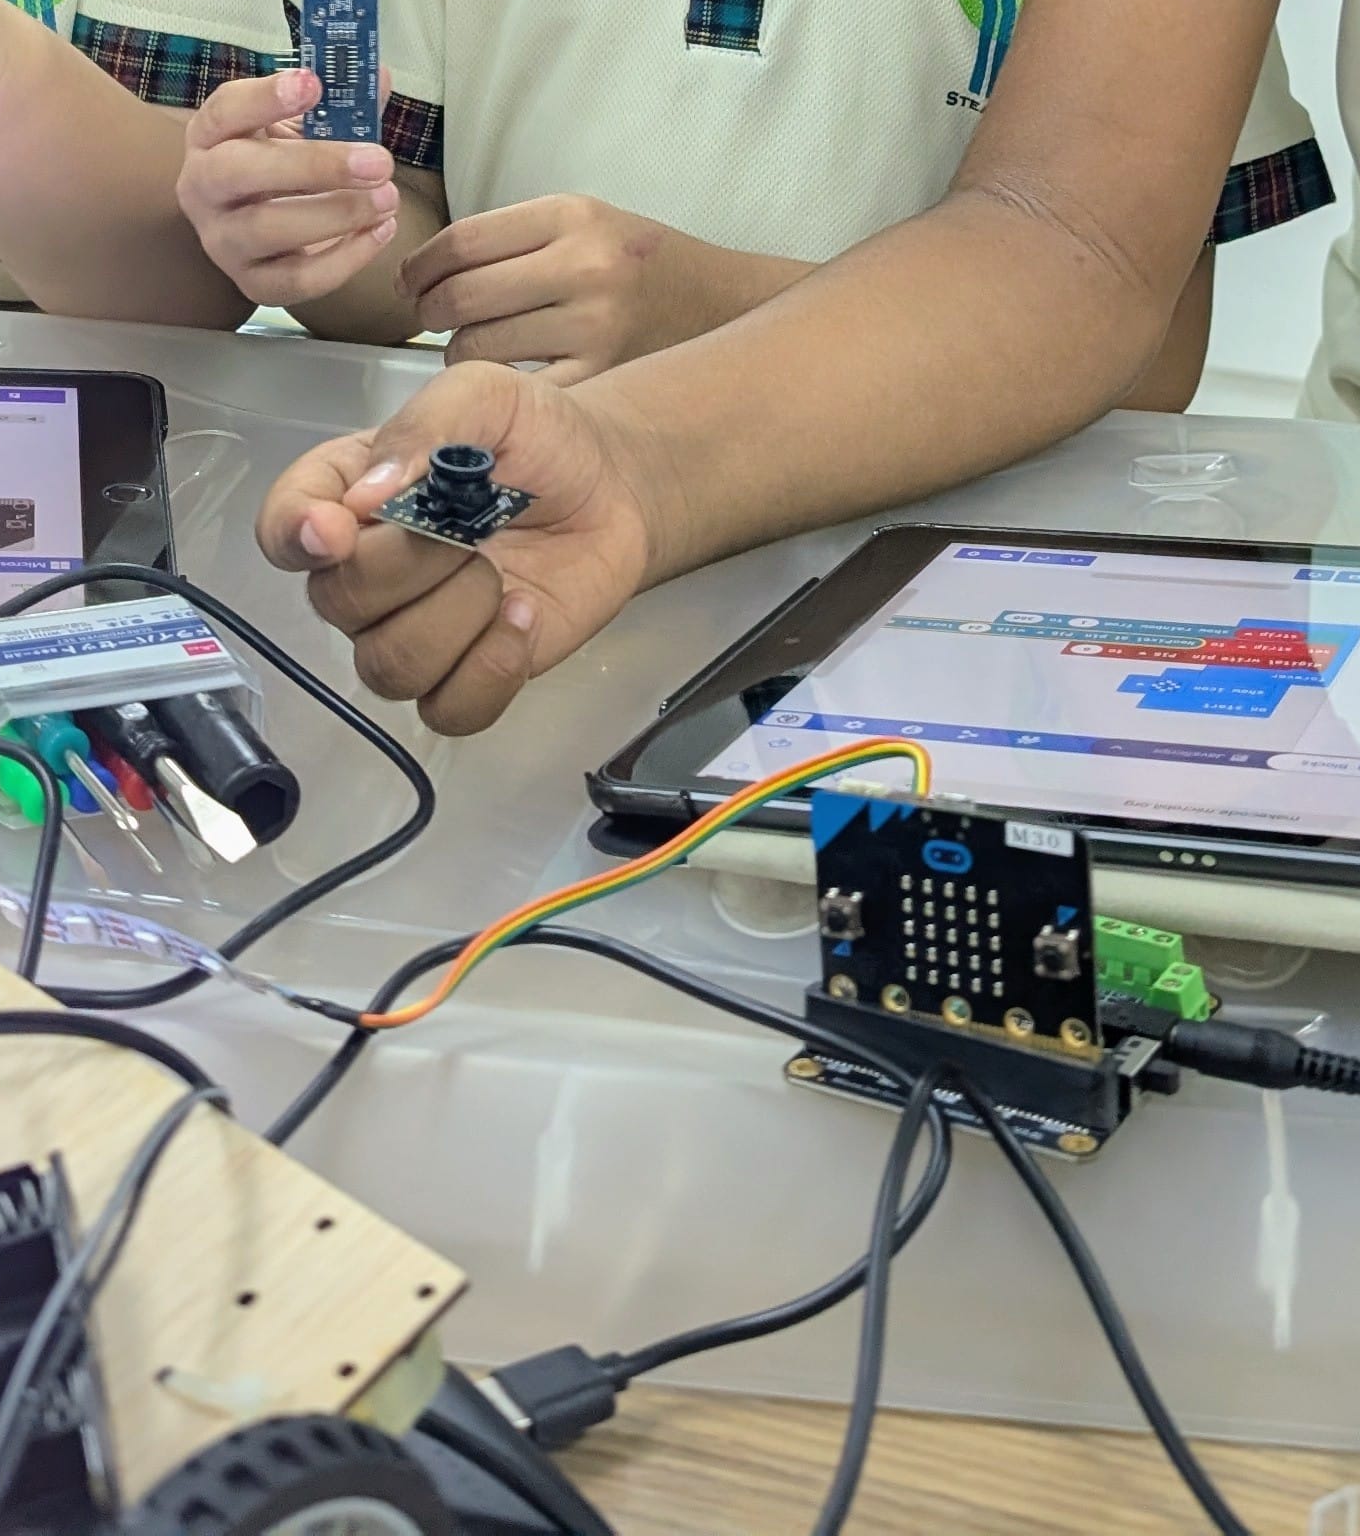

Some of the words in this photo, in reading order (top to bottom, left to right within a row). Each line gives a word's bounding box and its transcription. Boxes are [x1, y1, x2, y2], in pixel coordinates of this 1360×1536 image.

[1104, 621, 1134, 629] from
[1140, 624, 1193, 632] rainbow
[1259, 631, 1298, 639] strip
[1192, 654, 1217, 662] pin
[1221, 656, 1261, 664] write
[1269, 659, 1322, 668] digital
[1271, 674, 1326, 682] forever
[1193, 686, 1224, 694] icon
[1203, 703, 1242, 711] start
[1012, 828, 1061, 850] M30
